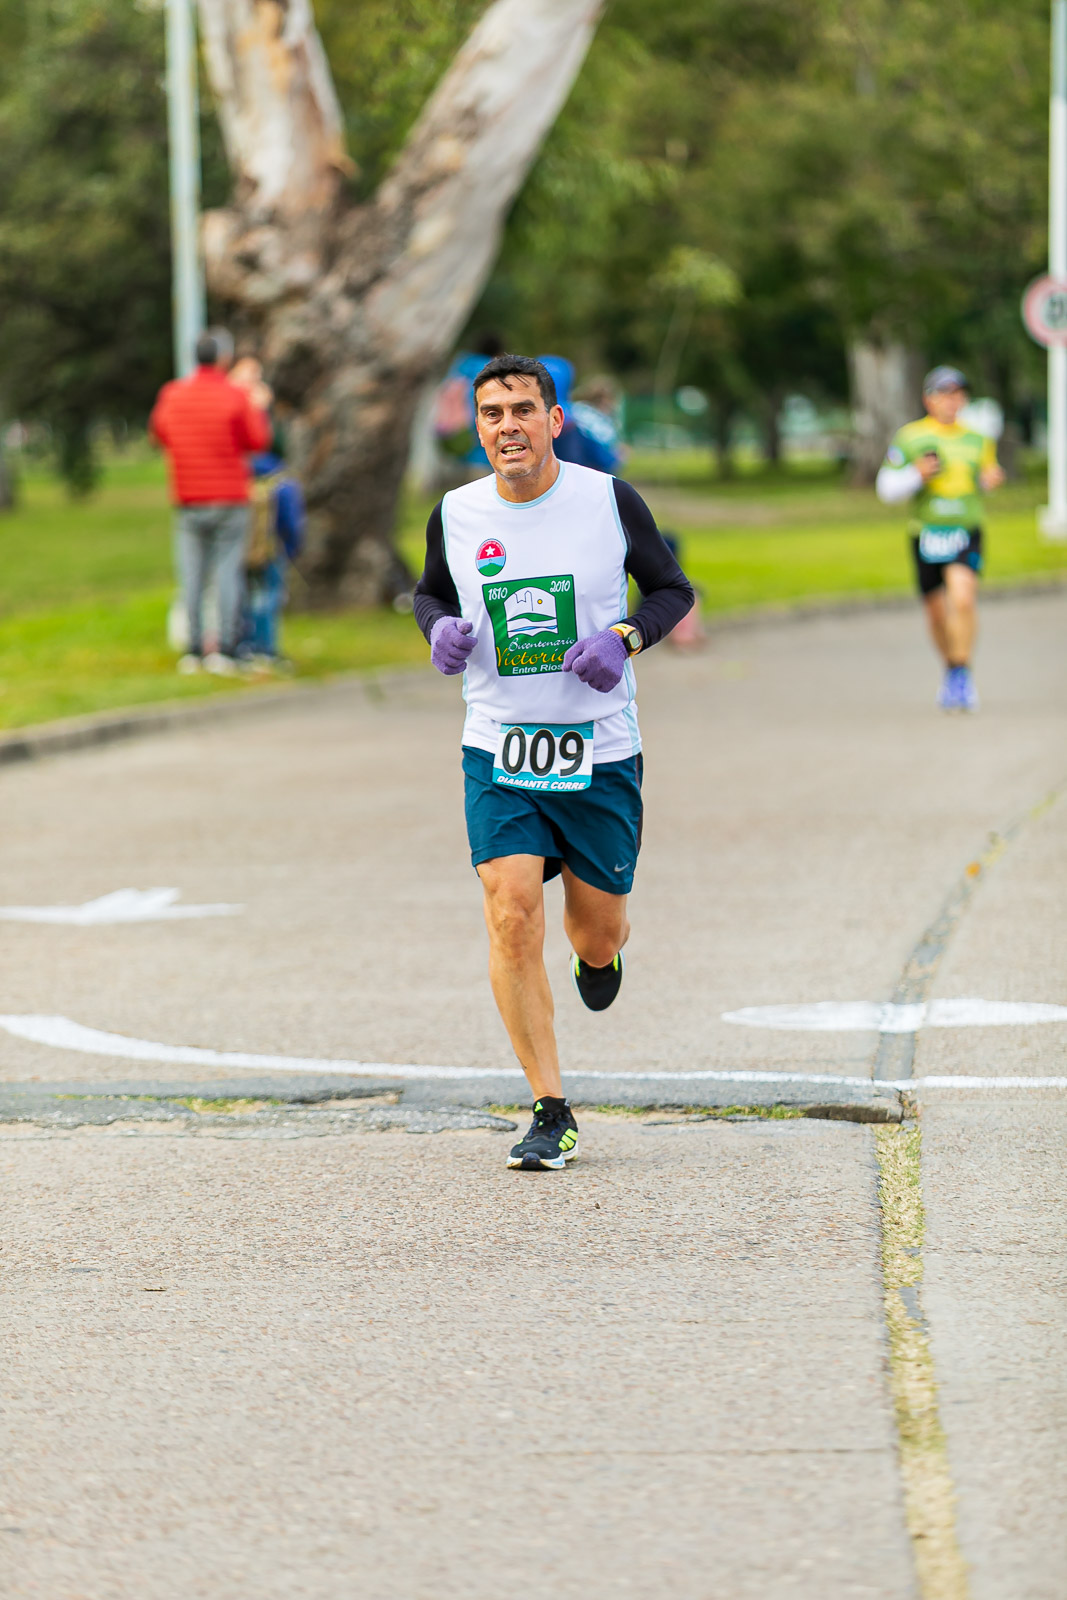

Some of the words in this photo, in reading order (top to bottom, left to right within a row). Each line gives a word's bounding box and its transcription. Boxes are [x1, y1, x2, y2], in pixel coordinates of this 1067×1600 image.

[550, 580, 570, 592] 2010
[488, 587, 507, 600] 1810
[509, 637, 575, 651] Bicentenario
[512, 664, 537, 674] Entre
[502, 727, 584, 777] 009
[497, 776, 549, 789] DIAMANTE
[550, 782, 585, 790] CORRE
